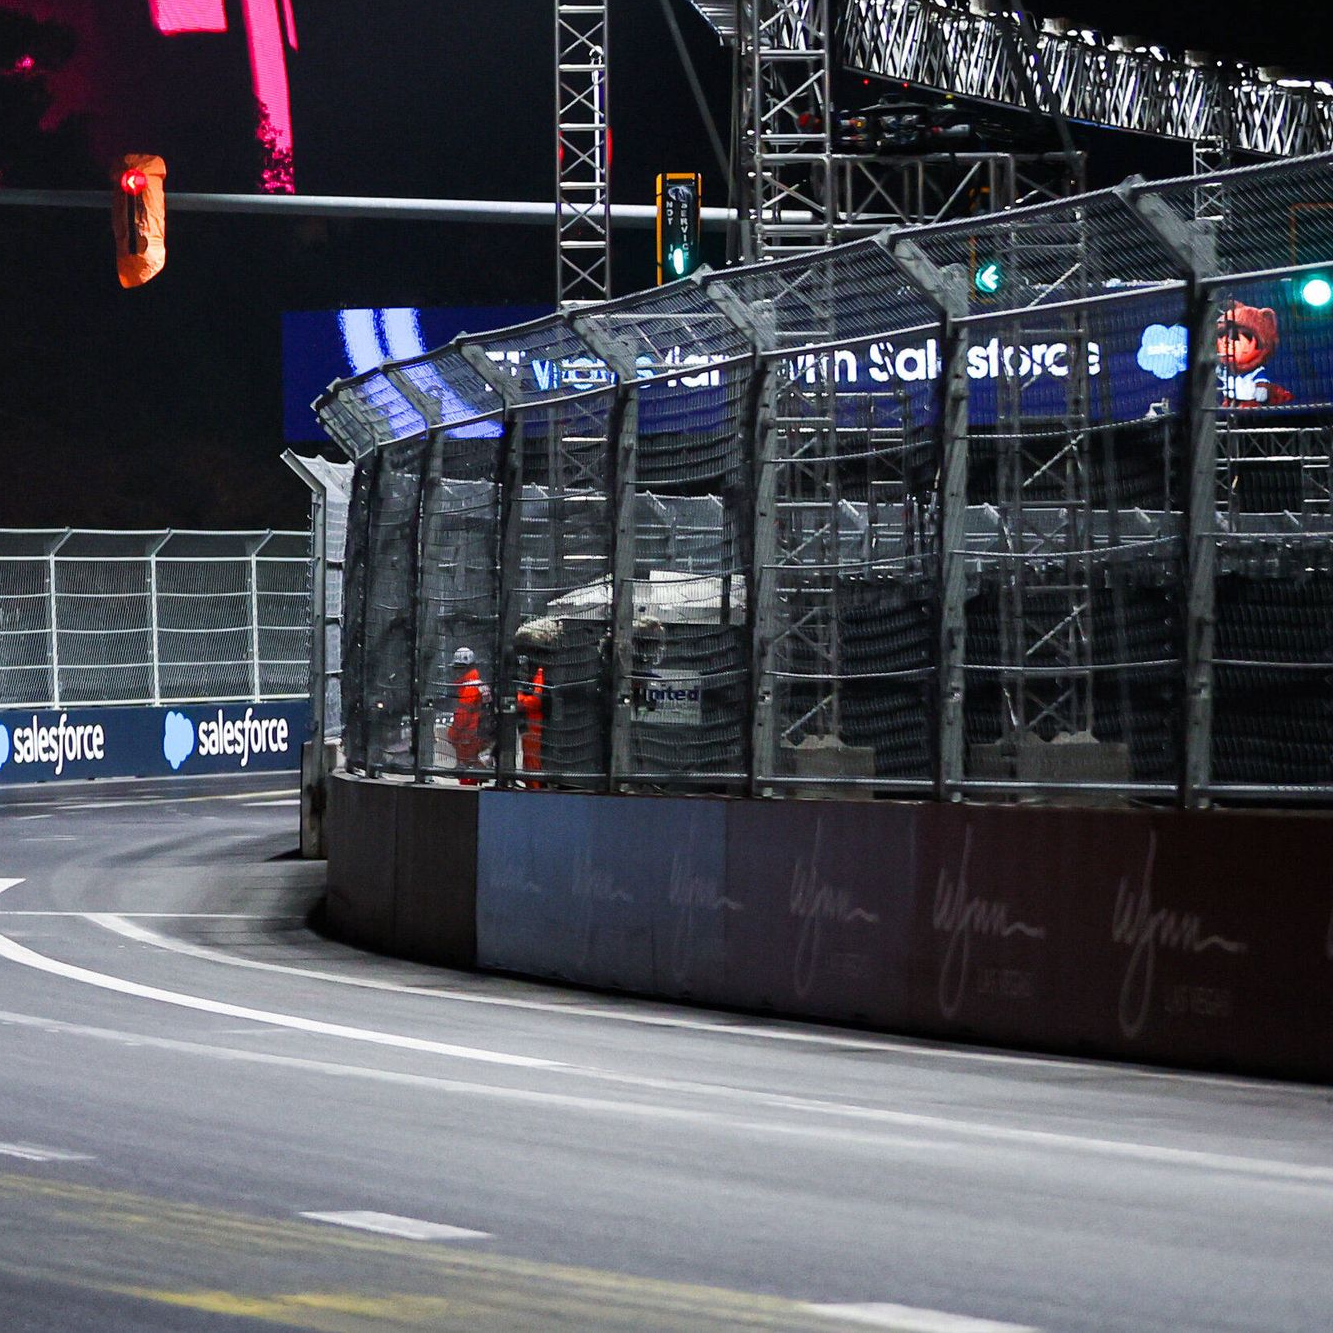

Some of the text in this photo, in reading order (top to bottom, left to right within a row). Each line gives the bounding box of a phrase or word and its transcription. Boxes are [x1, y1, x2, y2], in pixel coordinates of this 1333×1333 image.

[666, 201, 674, 225] NOT
[13, 713, 104, 775] salesforce
[199, 707, 288, 766] salesforce
